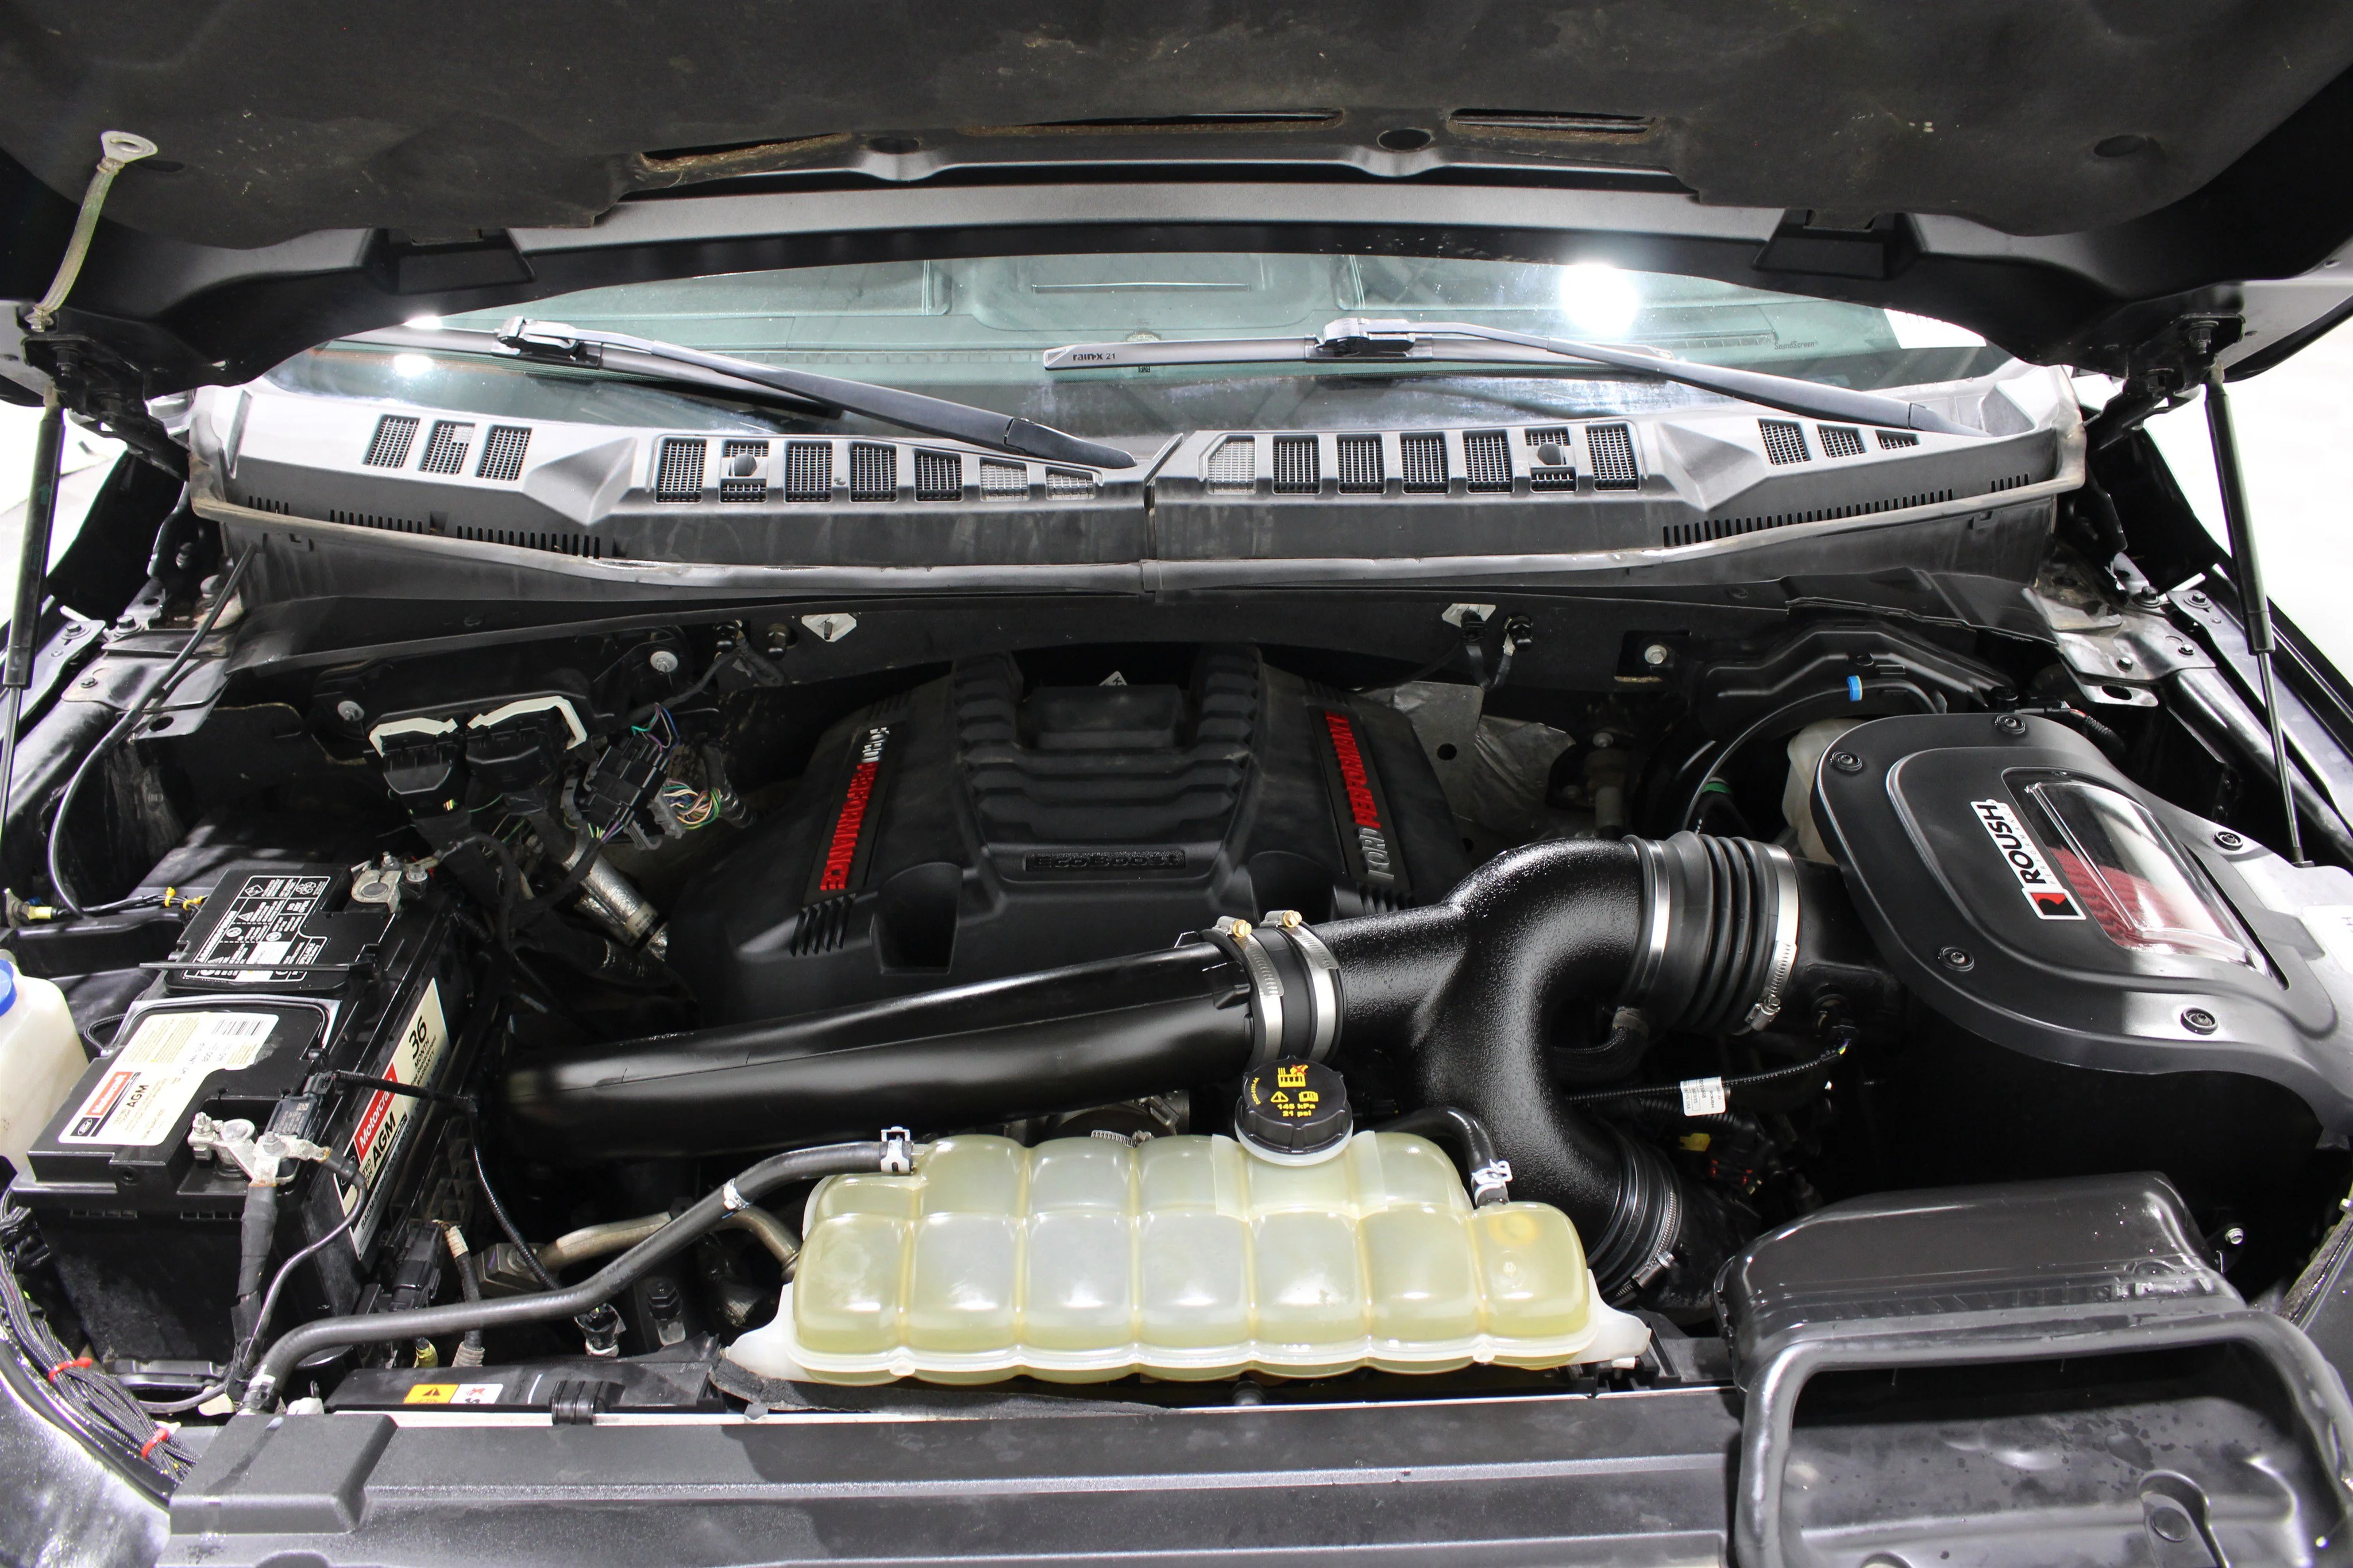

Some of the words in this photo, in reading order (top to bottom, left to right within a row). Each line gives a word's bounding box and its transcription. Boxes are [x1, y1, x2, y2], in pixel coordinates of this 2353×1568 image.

[1325, 710, 1382, 829] PERFORMANCE
[1358, 827, 1395, 881] FORD
[1977, 804, 2047, 884] ROUSH
[2000, 805, 2057, 885] PERFORMANCE
[407, 1015, 428, 1060] 36
[414, 1037, 430, 1069] MONTH
[91, 1074, 128, 1113] Motorcraft
[416, 1048, 435, 1086] WARRANTY
[125, 1083, 149, 1107] AGM
[357, 1076, 393, 1149] Motorcra
[368, 1111, 397, 1168] AGM
